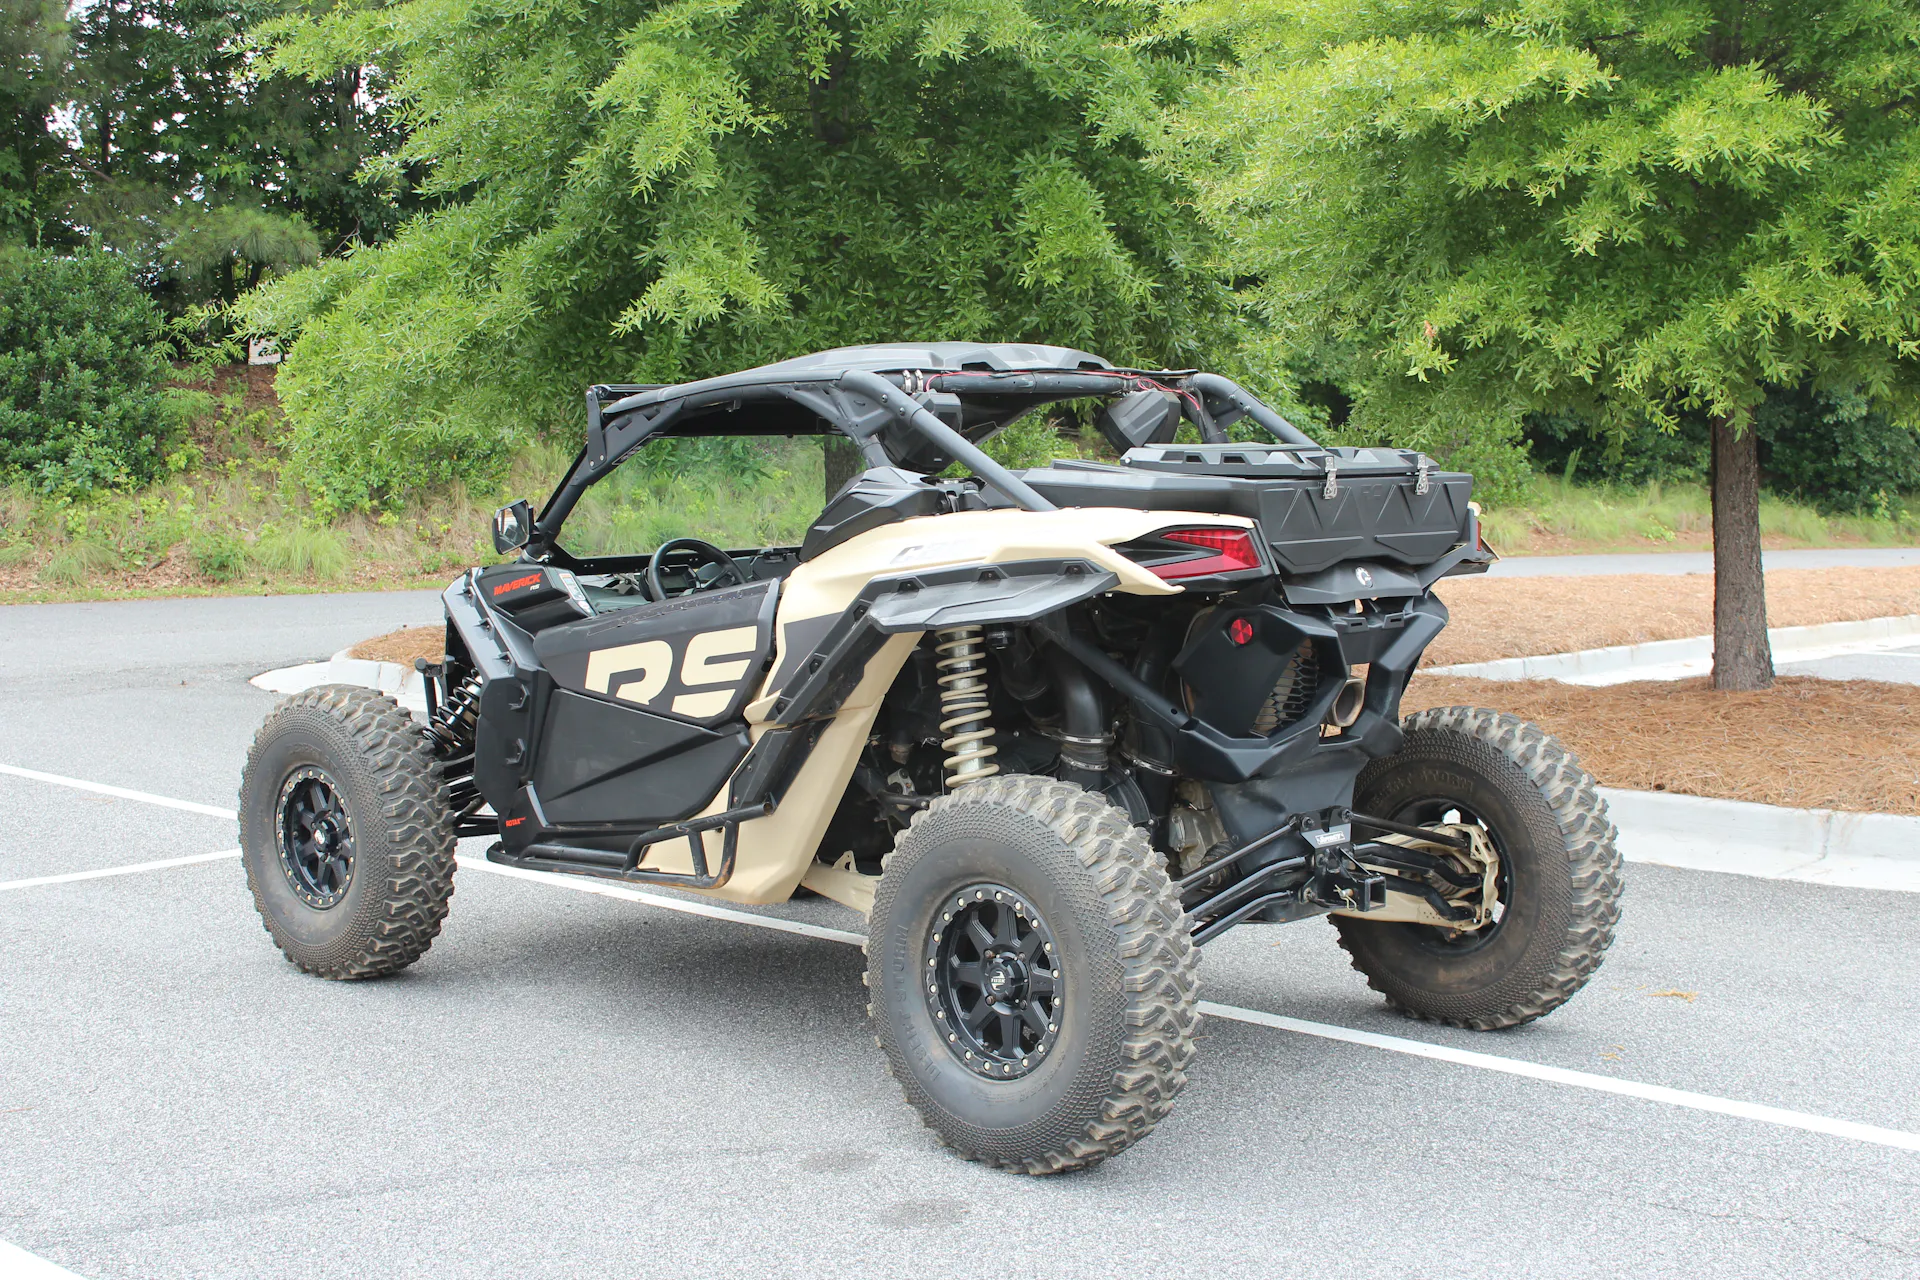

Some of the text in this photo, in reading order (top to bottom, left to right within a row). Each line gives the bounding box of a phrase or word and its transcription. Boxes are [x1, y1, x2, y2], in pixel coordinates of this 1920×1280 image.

[493, 572, 542, 596] MAVERICK
[584, 625, 758, 719] RS
[891, 924, 909, 1002] STORM
